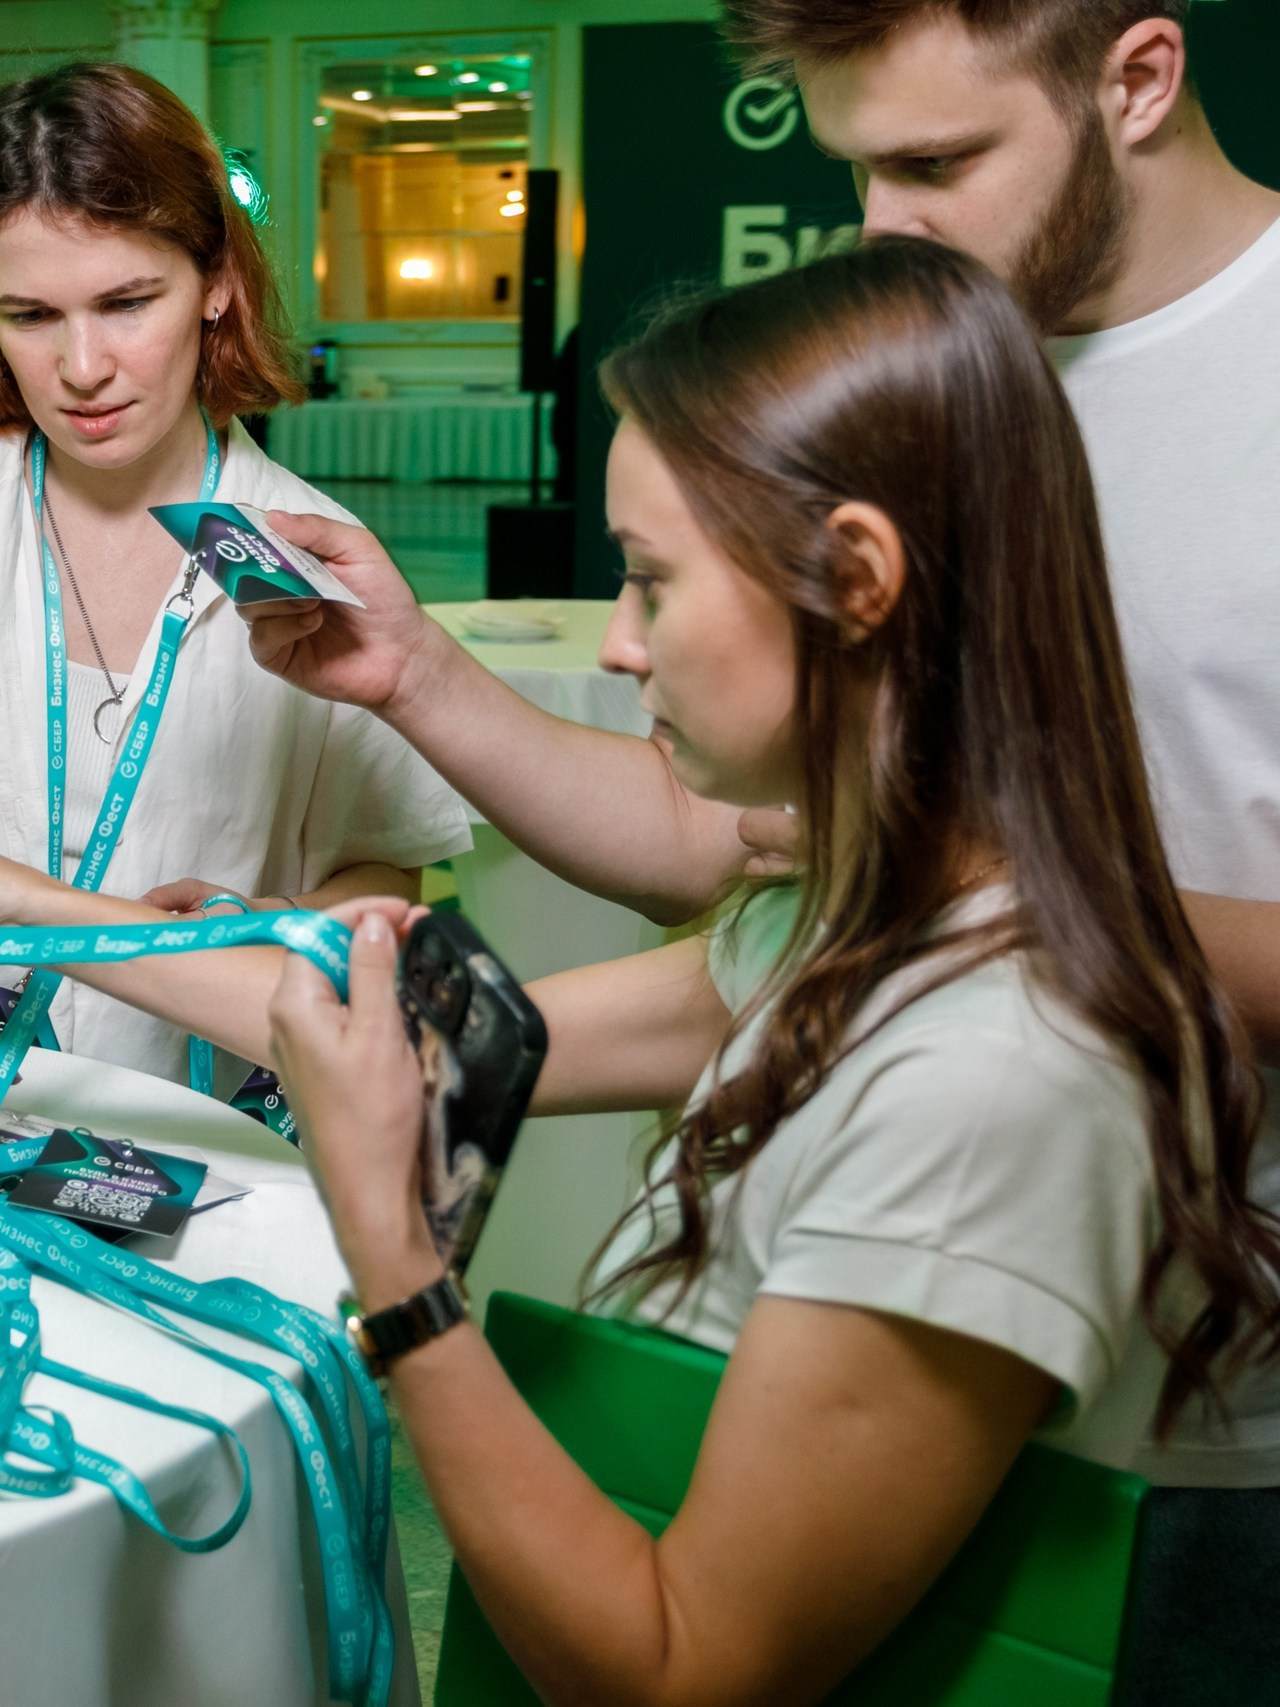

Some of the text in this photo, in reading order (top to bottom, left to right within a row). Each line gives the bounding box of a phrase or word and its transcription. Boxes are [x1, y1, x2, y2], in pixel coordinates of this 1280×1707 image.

[227, 527, 277, 573] Бизнес
[245, 533, 281, 566] Фест
[49, 608, 62, 707] Бизнес Фест
[128, 651, 170, 760] СБЕР Бизне
[53, 720, 64, 753] СБЕР
[52, 786, 62, 825] Фест
[81, 792, 125, 892] изнес Фест
[21, 983, 50, 1025] Фест
[278, 1112, 293, 1130] БУД
[63, 1168, 169, 1197] ПРОИСХОДЯЩЕГО
[78, 1167, 108, 1178] БУДЬ
[120, 1176, 160, 1191] КУРСЕ
[114, 1161, 156, 1177] СБЕР
[47, 1244, 82, 1275] Фест
[98, 1252, 199, 1302] Бизнес Фест
[274, 1325, 319, 1369] Фест
[11, 1421, 51, 1451] Фес
[266, 1374, 357, 1682] Бизнес Фест СБЕР Бизн
